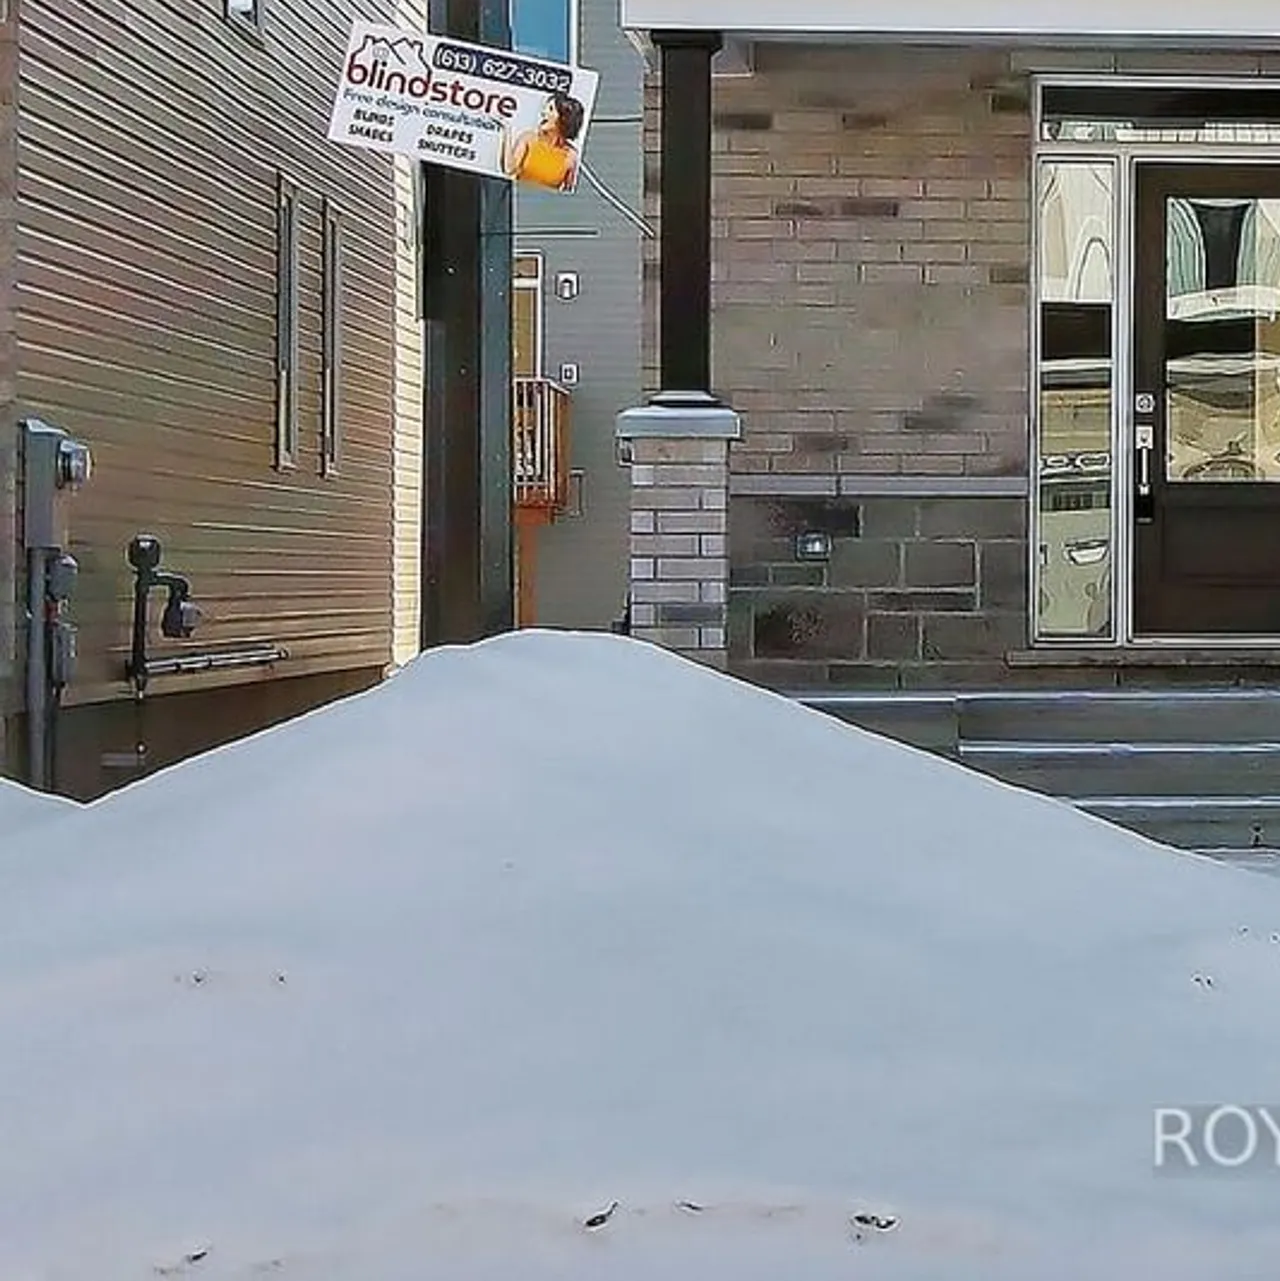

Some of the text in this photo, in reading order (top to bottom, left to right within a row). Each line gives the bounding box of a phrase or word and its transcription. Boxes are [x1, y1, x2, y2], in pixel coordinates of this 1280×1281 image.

[347, 58, 518, 118] blindstore
[436, 48, 572, 91] (613) 627-3032
